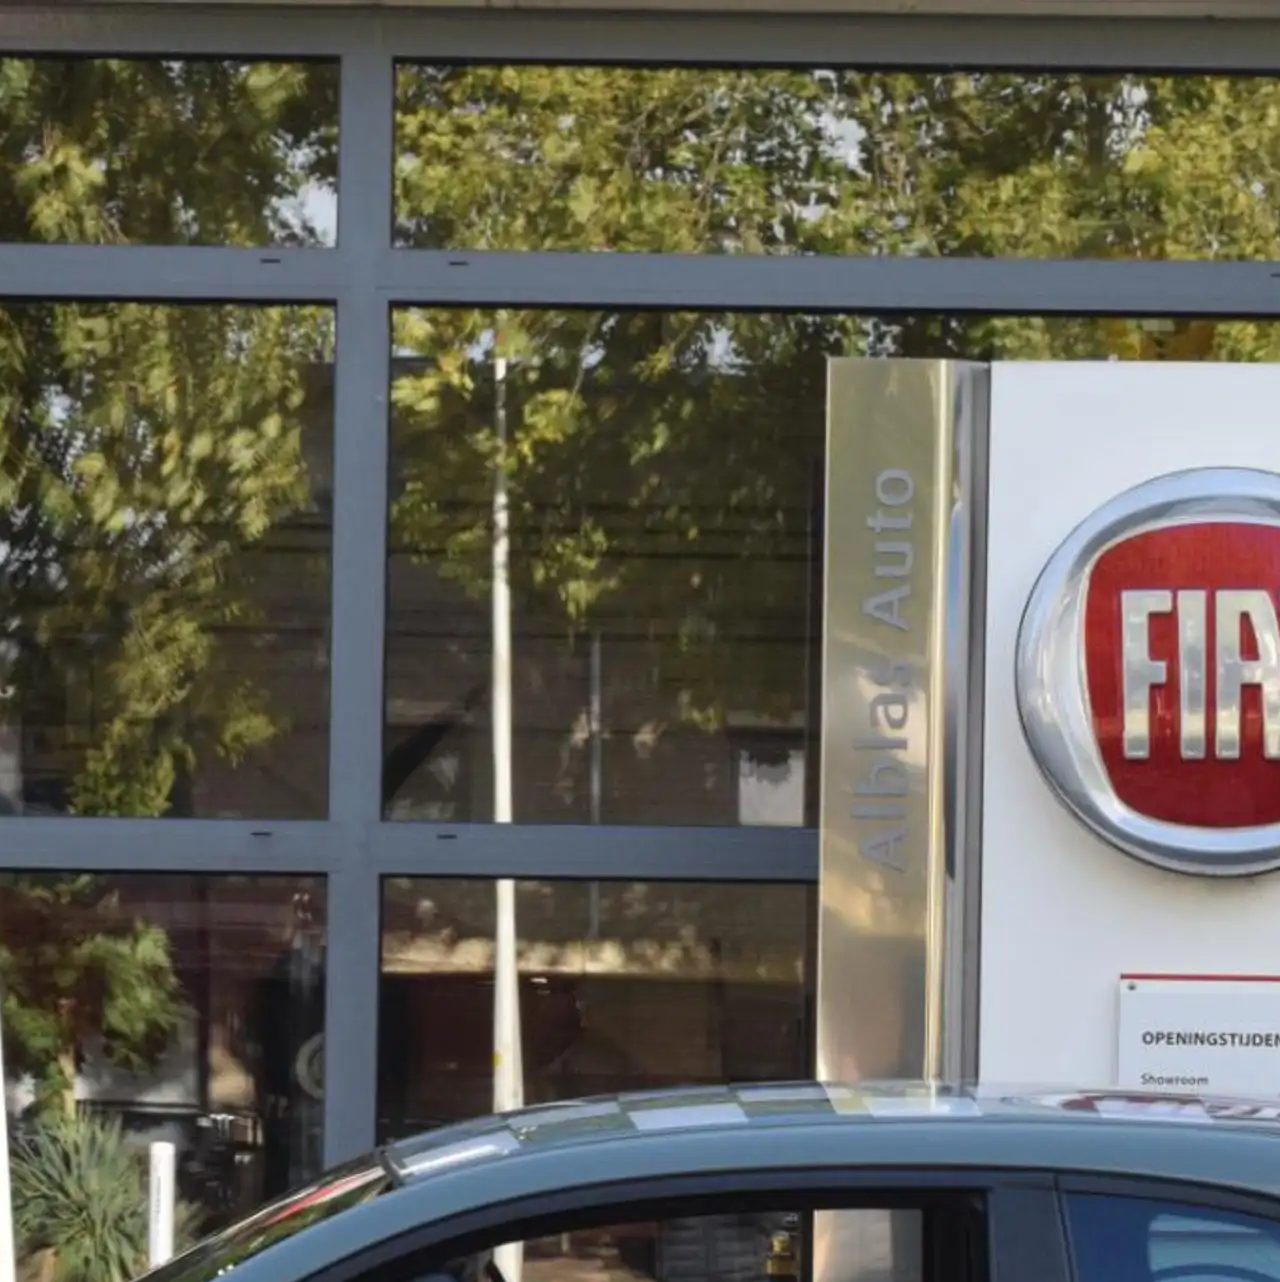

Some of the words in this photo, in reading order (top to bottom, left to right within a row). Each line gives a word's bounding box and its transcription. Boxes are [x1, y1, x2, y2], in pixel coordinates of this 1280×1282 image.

[861, 468, 915, 633] Auto
[850, 660, 911, 874] Alblas
[1140, 1072, 1210, 1086] Showroom
